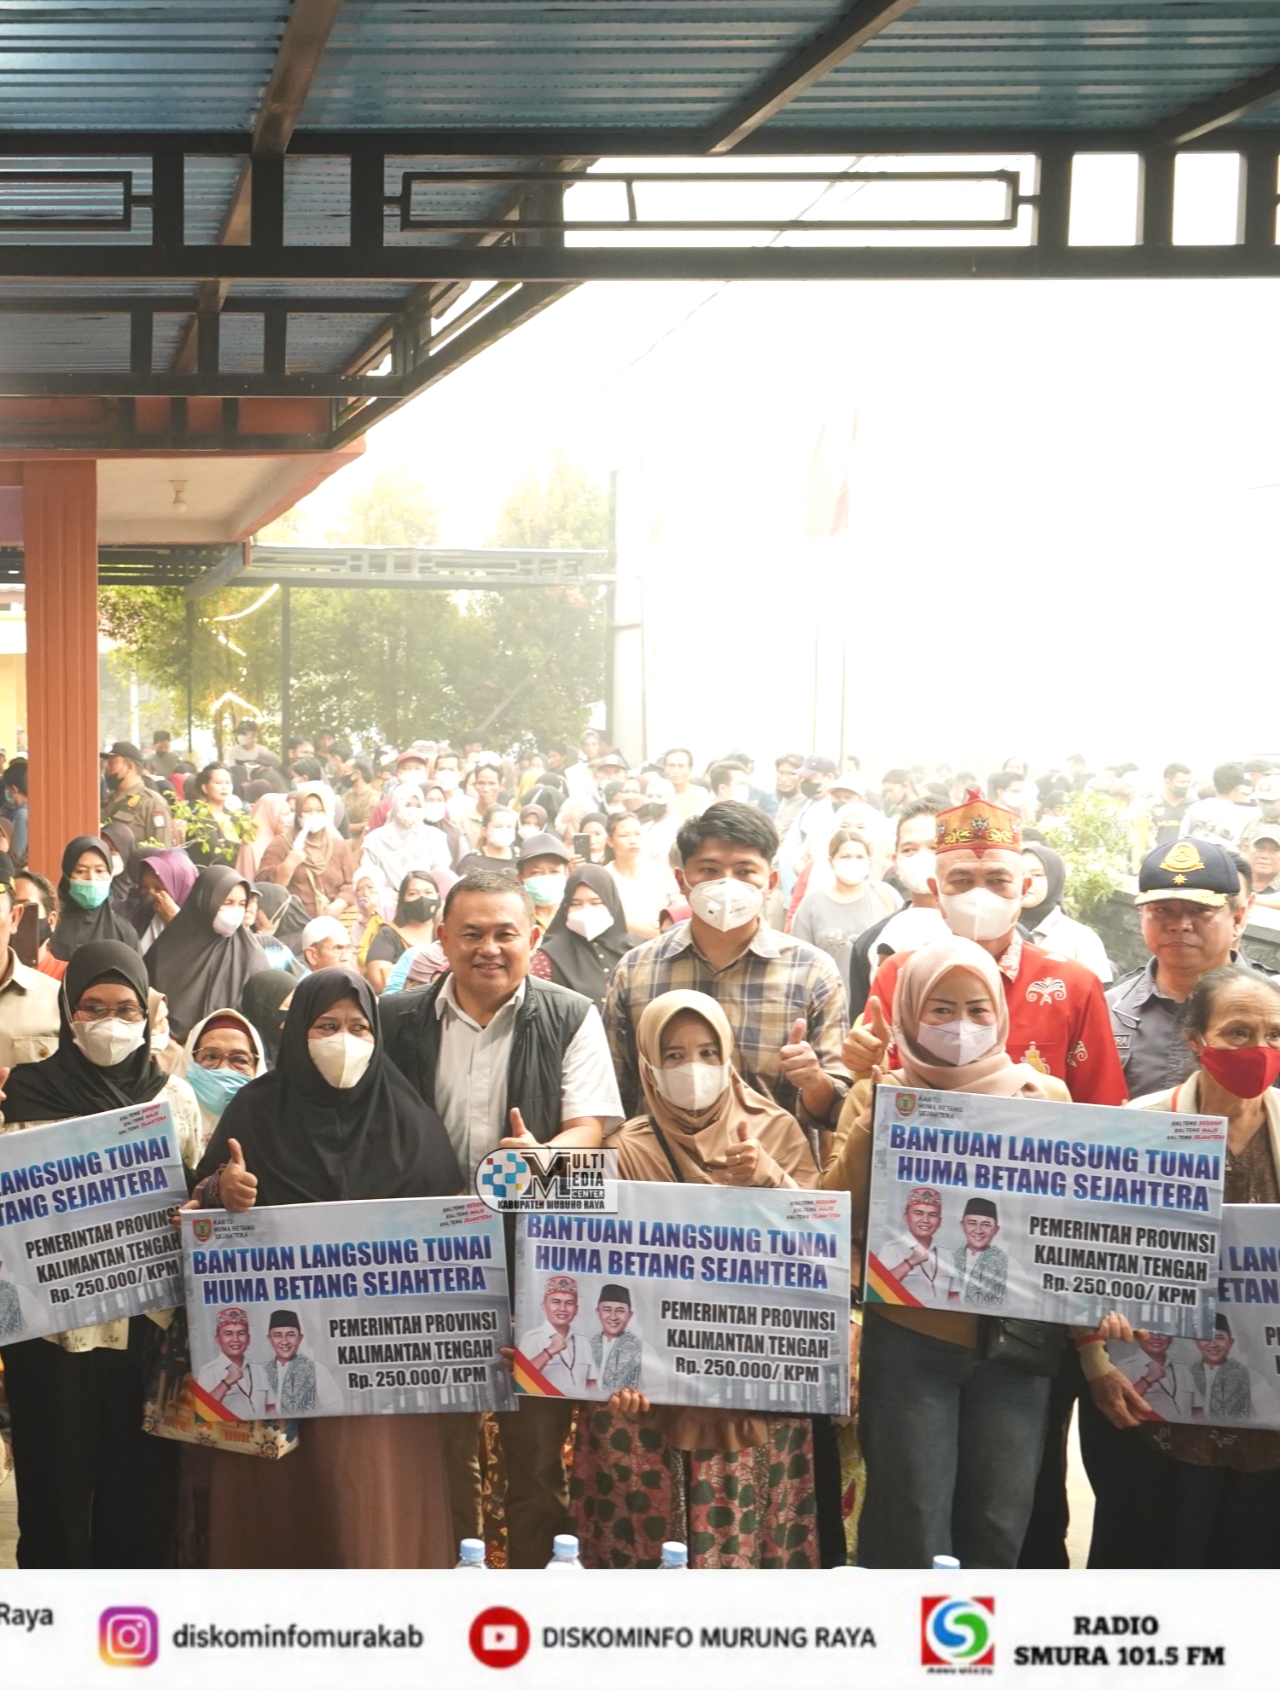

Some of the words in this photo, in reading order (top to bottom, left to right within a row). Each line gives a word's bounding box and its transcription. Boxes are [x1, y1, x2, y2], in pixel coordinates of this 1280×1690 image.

[104, 1136, 170, 1169] TUNAI
[890, 1124, 1002, 1159] BANTUAN
[1008, 1136, 1138, 1173] LANGSUNG
[1146, 1149, 1220, 1181] TUNAI
[53, 1166, 169, 1214] SEJAHTERA
[897, 1156, 968, 1187] HUMA
[974, 1163, 1066, 1198] BETANG
[1073, 1174, 1209, 1212] SEJAHTERA
[25, 1223, 114, 1259] PEMERINTAH
[116, 1206, 180, 1238] PROVINS
[527, 1214, 633, 1244] BANTUAN
[638, 1221, 761, 1254] LANGSUNG
[767, 1229, 837, 1259] TUNAI
[1029, 1216, 1132, 1246] PEMERINTAH
[1136, 1226, 1216, 1255] PROVINSI
[36, 1246, 125, 1284] KALIMANTAN
[126, 1232, 182, 1261] TENGAH
[193, 1245, 295, 1275] BANTUAN
[300, 1238, 418, 1269] LANGSUNG
[423, 1235, 492, 1262] TUNAI
[535, 1245, 602, 1274] HUMA
[608, 1250, 695, 1281] BETANG
[700, 1256, 828, 1290] SEJAHTERA
[1034, 1244, 1138, 1276] KALIMANTAN
[1142, 1255, 1207, 1281] TENGAH
[1228, 1246, 1280, 1272] LAN
[50, 1286, 74, 1304] Rp.
[75, 1268, 143, 1299] 250.000/
[146, 1260, 179, 1281] KPM
[203, 1277, 269, 1305] HUMA
[274, 1273, 358, 1301] BETANG
[363, 1266, 487, 1297] SEJAHTERA
[1042, 1273, 1069, 1293] Rp.
[1073, 1276, 1155, 1301] 250.000/
[1158, 1284, 1196, 1306] KPM
[1218, 1278, 1280, 1304] ETAN
[329, 1314, 420, 1338] PEMERINTAH
[425, 1311, 497, 1334] PROVINSI
[660, 1300, 757, 1326] PEMERINTAH
[761, 1306, 836, 1331] PROVINSI
[337, 1342, 432, 1365] KALIMANTAN
[436, 1339, 493, 1361] TENGAH
[666, 1328, 765, 1355] KALIMANTAN
[768, 1335, 829, 1359] TENGAH
[348, 1372, 373, 1390] Rp.
[376, 1367, 449, 1388] 250.000/
[453, 1366, 487, 1384] KPM
[675, 1357, 700, 1377] Rp.
[704, 1359, 781, 1381] 250.000/
[784, 1364, 819, 1383] KPM
